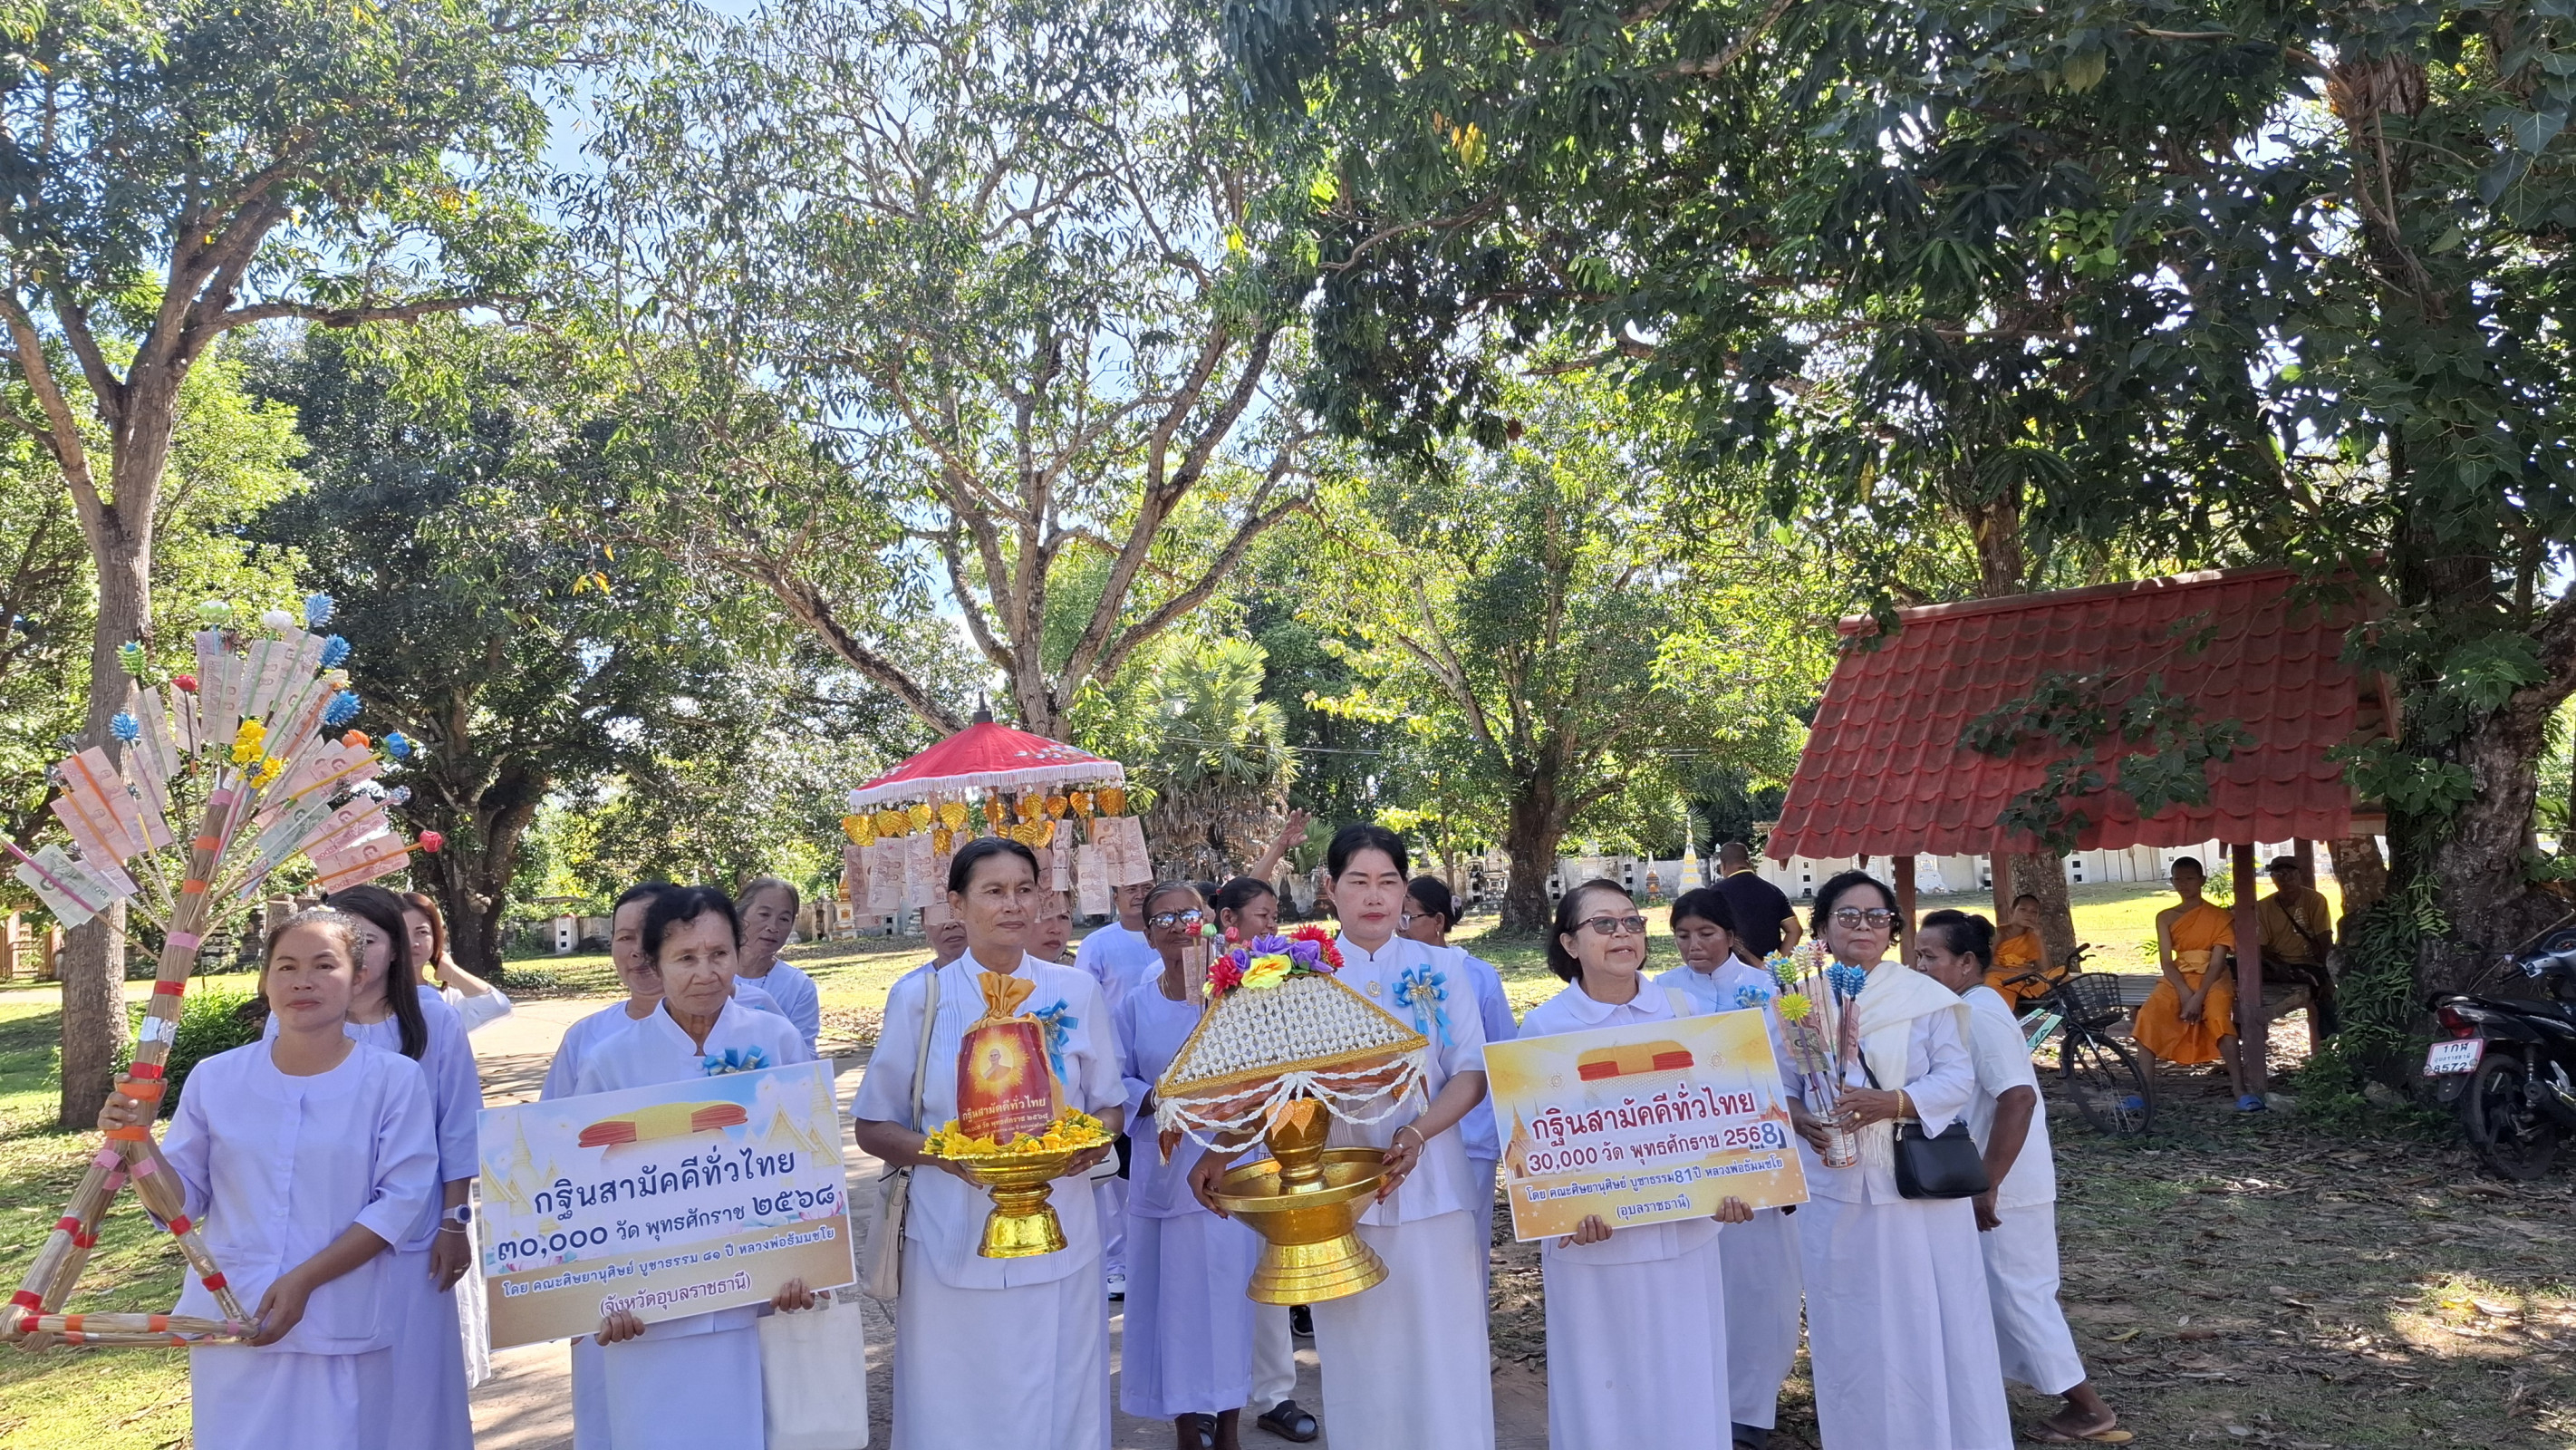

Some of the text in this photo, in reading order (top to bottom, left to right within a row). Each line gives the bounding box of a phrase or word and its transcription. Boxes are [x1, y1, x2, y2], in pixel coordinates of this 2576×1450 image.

[2433, 1062, 2467, 1073] 8572
[1532, 1083, 1756, 1147] กฐินสามัคคีทั่วไทย
[1529, 1122, 1779, 1172] 30,000 วัด พุทธศักราช 2568
[534, 1146, 796, 1220] กฐินสามัคคีทั่วไทย
[1526, 1186, 1546, 1202] โดย
[1550, 1175, 1627, 1198] คณะศิษยานุศิษย์
[1616, 1195, 1691, 1221] (อุบลราชธานี)
[498, 1183, 835, 1261] ๓๐,๐๐๐ วัด พุทธศักราช ๒๕๖๘
[503, 1281, 528, 1297] โดย
[534, 1260, 634, 1291] คณะศิษยานุศิษย์
[639, 1253, 699, 1277] บูชาธรรม
[725, 1243, 734, 1256] ปี
